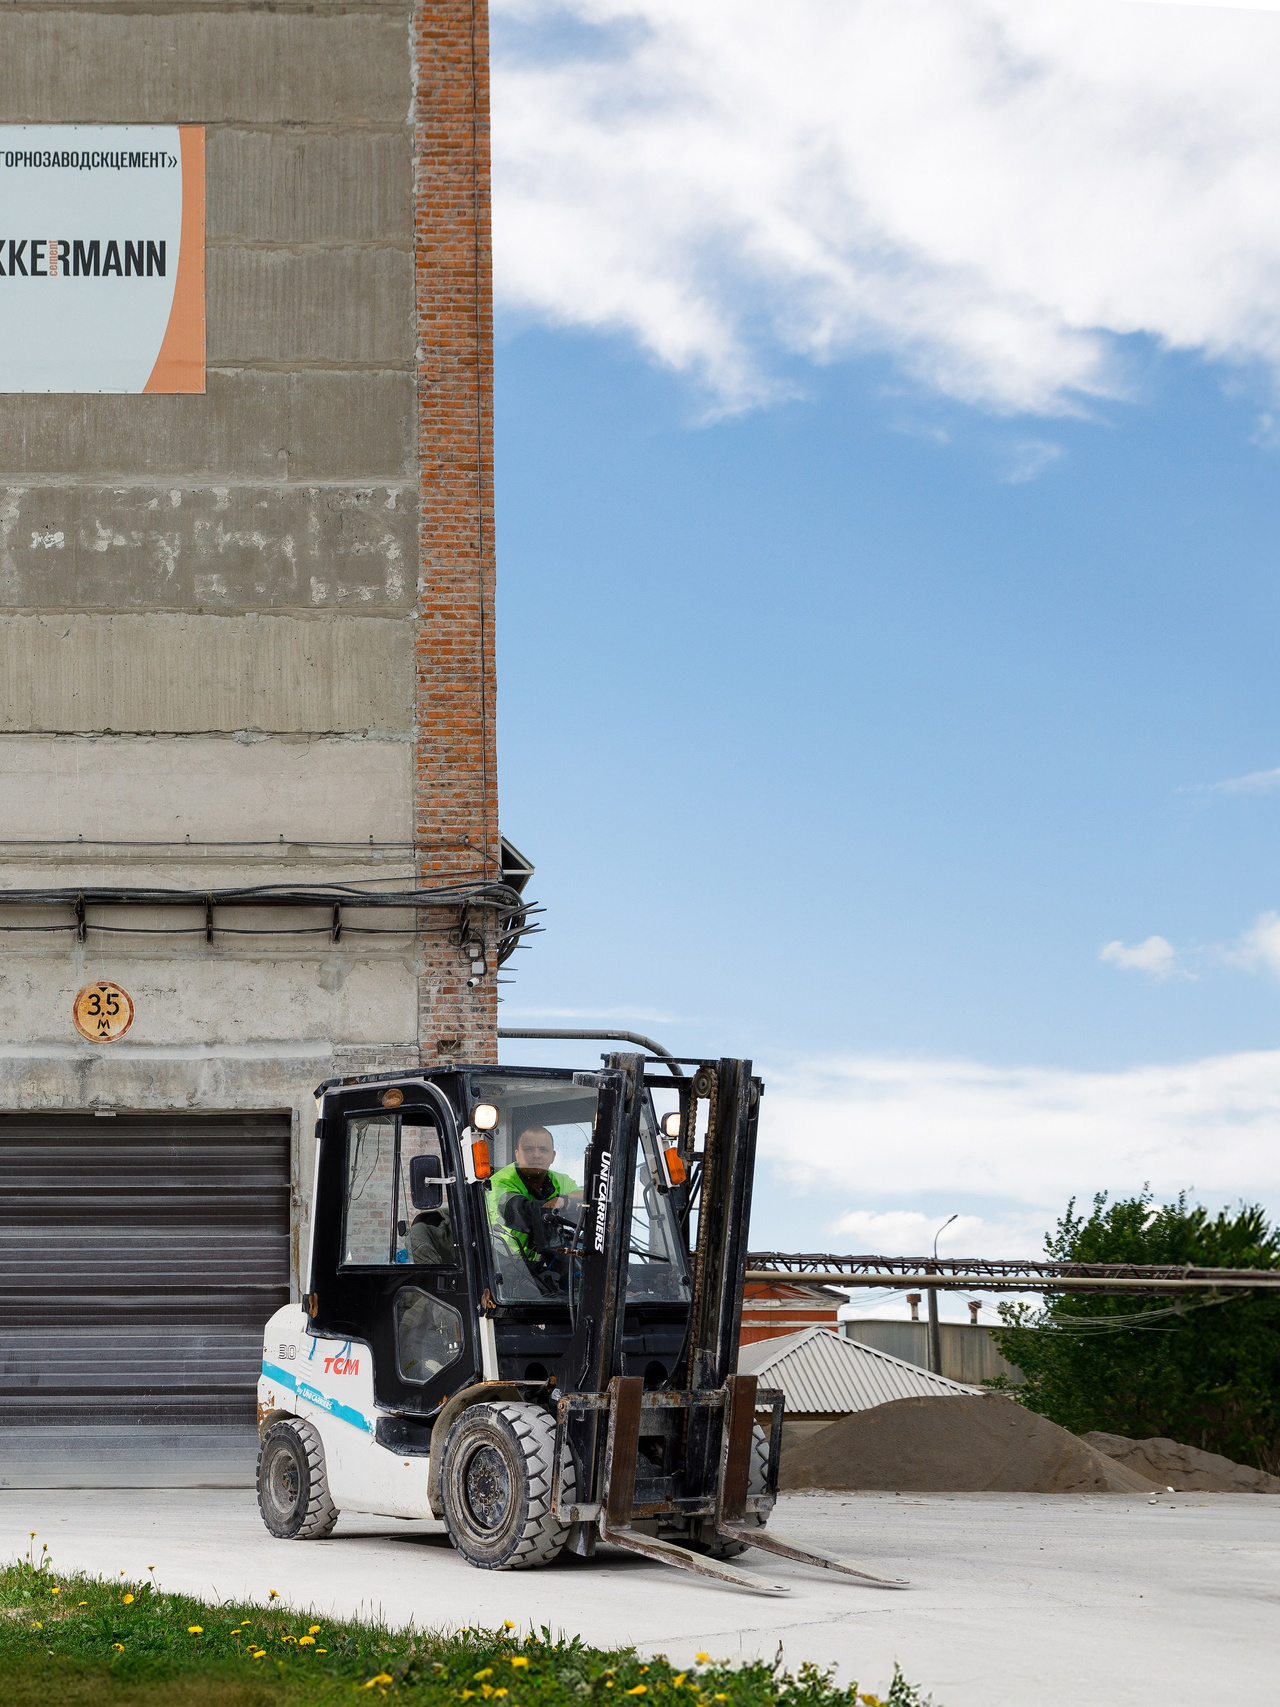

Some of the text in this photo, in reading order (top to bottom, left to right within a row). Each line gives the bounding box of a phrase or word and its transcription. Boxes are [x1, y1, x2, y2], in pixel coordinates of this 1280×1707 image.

[48, 239, 58, 277] cement
[87, 993, 119, 1017] 3,5
[323, 1357, 360, 1375] TCM
